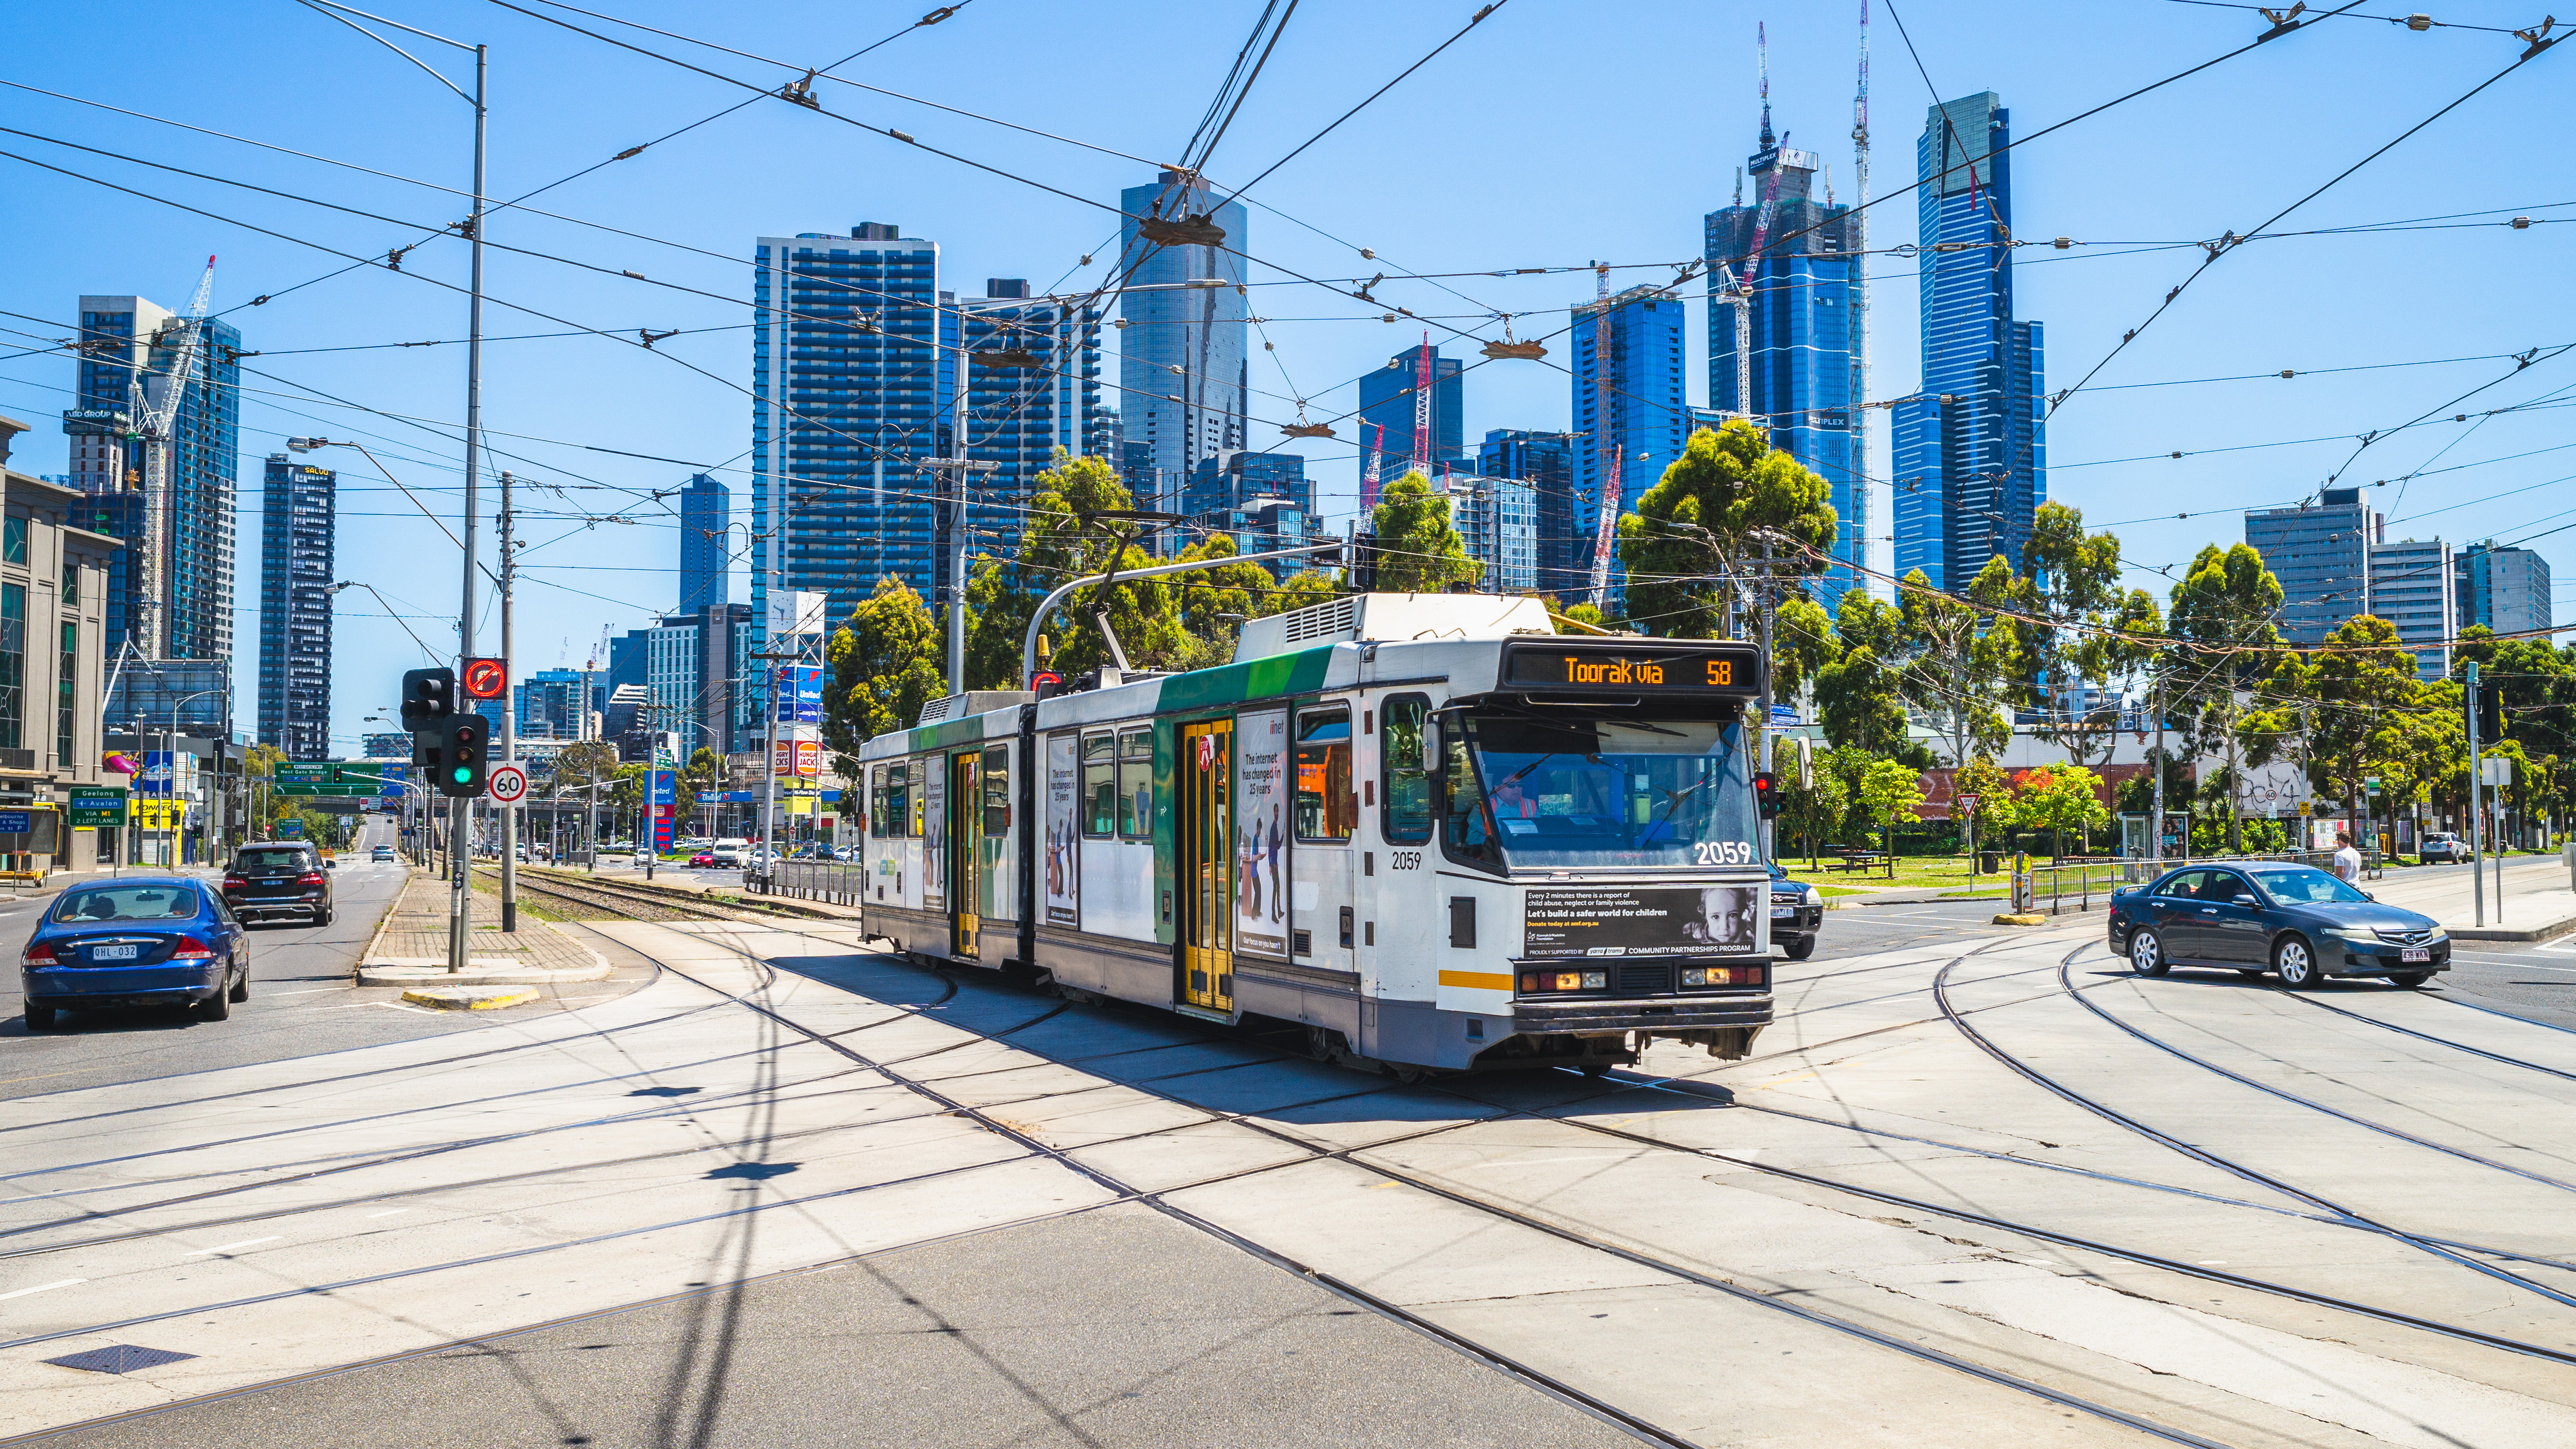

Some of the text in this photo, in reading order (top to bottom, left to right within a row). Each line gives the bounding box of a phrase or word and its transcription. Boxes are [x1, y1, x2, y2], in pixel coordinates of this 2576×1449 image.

[1750, 152, 1776, 166] MULTIPLEX
[1808, 415, 1844, 425] MULTIPLEX
[1565, 658, 1730, 684] Toorak via 58
[799, 690, 821, 699] United
[1200, 740, 1209, 750] STOP
[1246, 752, 1277, 765] The internet
[1059, 768, 1073, 777] internet
[1242, 766, 1281, 782] has changed in
[497, 776, 519, 792] 60
[1056, 780, 1071, 791] changed
[1071, 780, 1075, 788] in
[1250, 783, 1270, 797] 25 years
[1055, 792, 1069, 803] 25 years
[1695, 841, 1751, 865] 2059
[1392, 851, 1421, 870] 2059
[1249, 937, 1258, 946] focus
